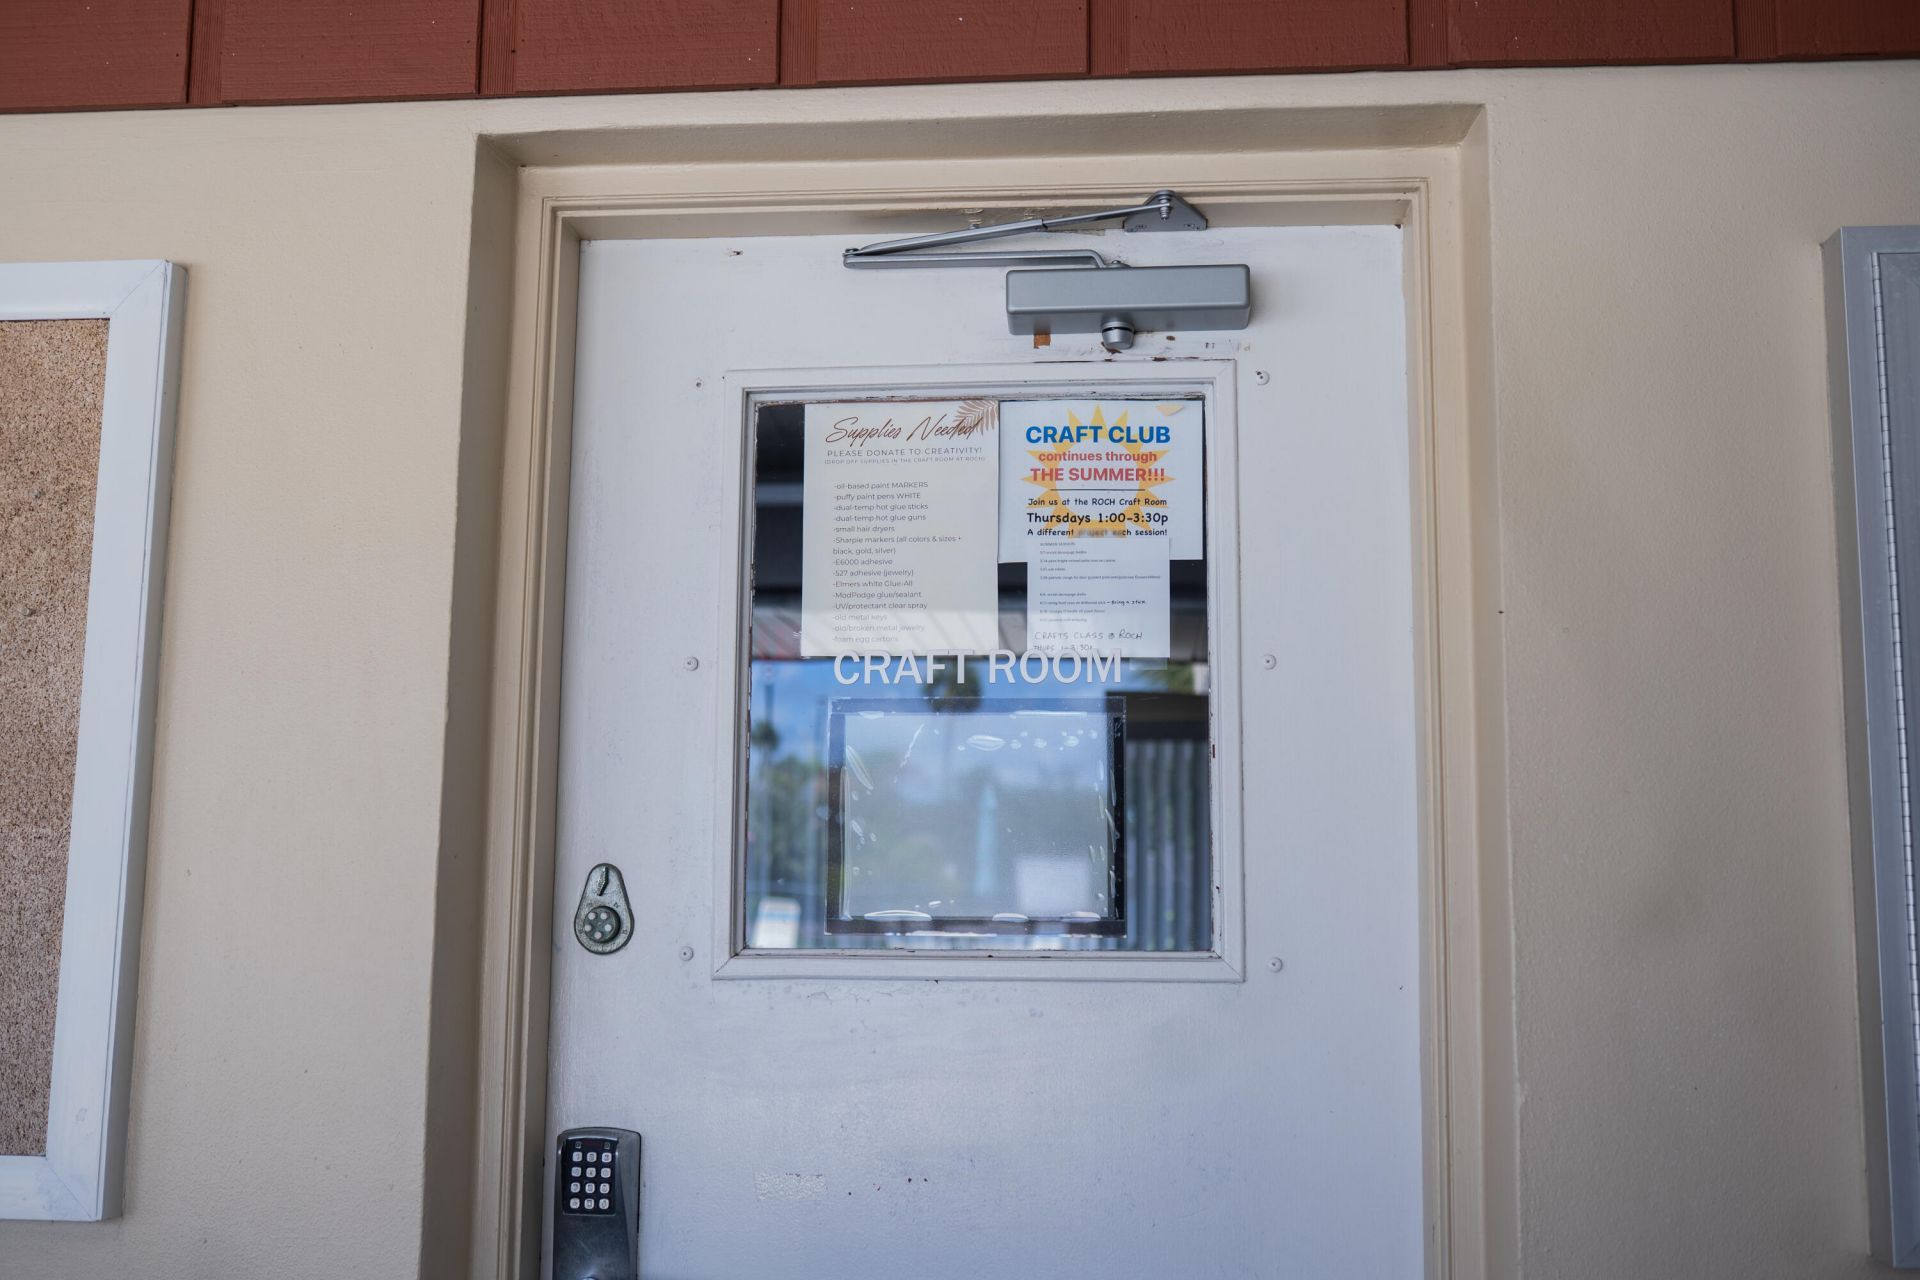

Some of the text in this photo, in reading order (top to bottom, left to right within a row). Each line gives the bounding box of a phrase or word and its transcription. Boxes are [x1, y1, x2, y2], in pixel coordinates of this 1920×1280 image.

[826, 414, 983, 447] Supplies Needed
[1026, 426, 1170, 444] CRAFT CLUB
[1039, 451, 1156, 463] continues through
[1031, 468, 1165, 481] THE SUMMER!!!
[1027, 513, 1168, 525] Thursdays 1:00-3:30p
[1034, 632, 1068, 640] CRAFTS
[834, 649, 1121, 684] CRAFT ROOM
